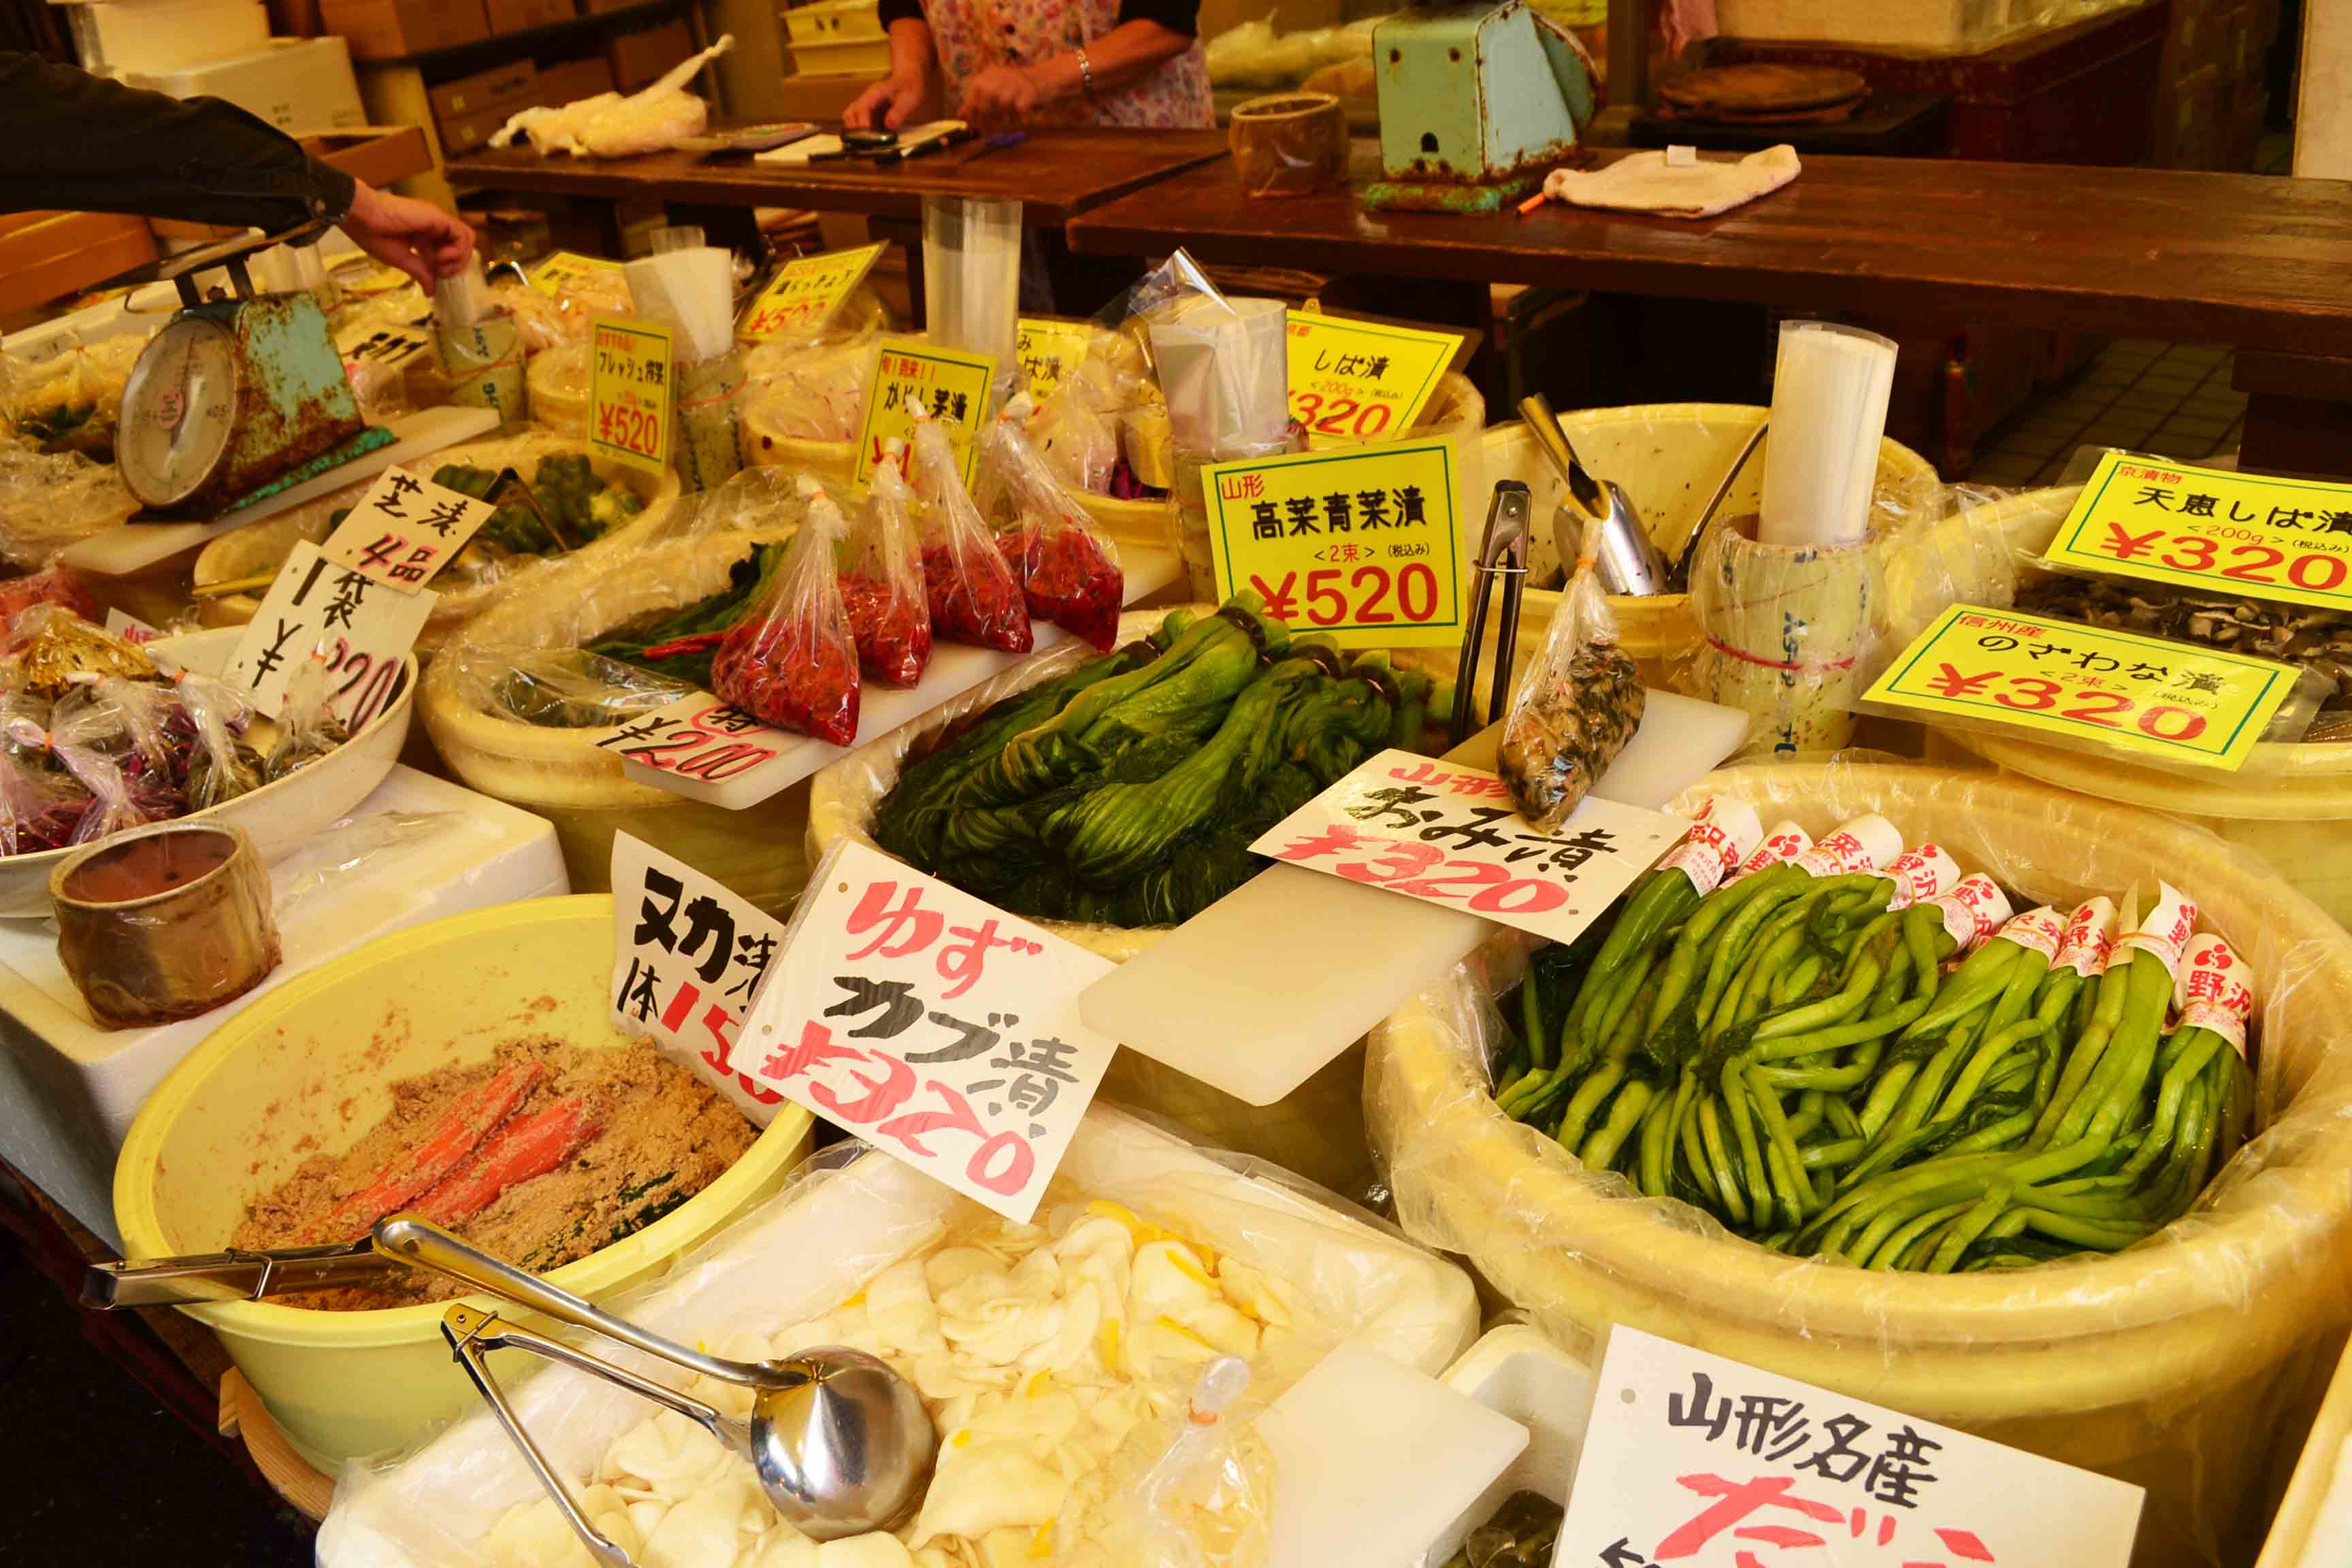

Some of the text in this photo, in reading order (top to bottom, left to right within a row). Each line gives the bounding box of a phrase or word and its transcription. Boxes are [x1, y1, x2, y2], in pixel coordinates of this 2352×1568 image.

[1314, 348, 1390, 380] しば漬
[598, 400, 658, 455] ¥520
[1288, 389, 1391, 437] 320
[1222, 473, 1264, 500] 山形
[1251, 485, 1427, 540] 高菜青菜漬
[359, 533, 437, 583] 4品
[2101, 522, 2347, 591] ¥320
[1250, 563, 1439, 626] ¥520
[1978, 635, 2227, 696] のざわな漬
[1927, 662, 2208, 741] ¥320
[1274, 823, 1571, 914] ¥320
[845, 881, 1044, 1000] ゆず
[823, 975, 1081, 1139] カブ漬
[759, 1019, 1035, 1197] ¥320
[1667, 1371, 1945, 1509] 山形名産
[1654, 1476, 1996, 1568] だ
